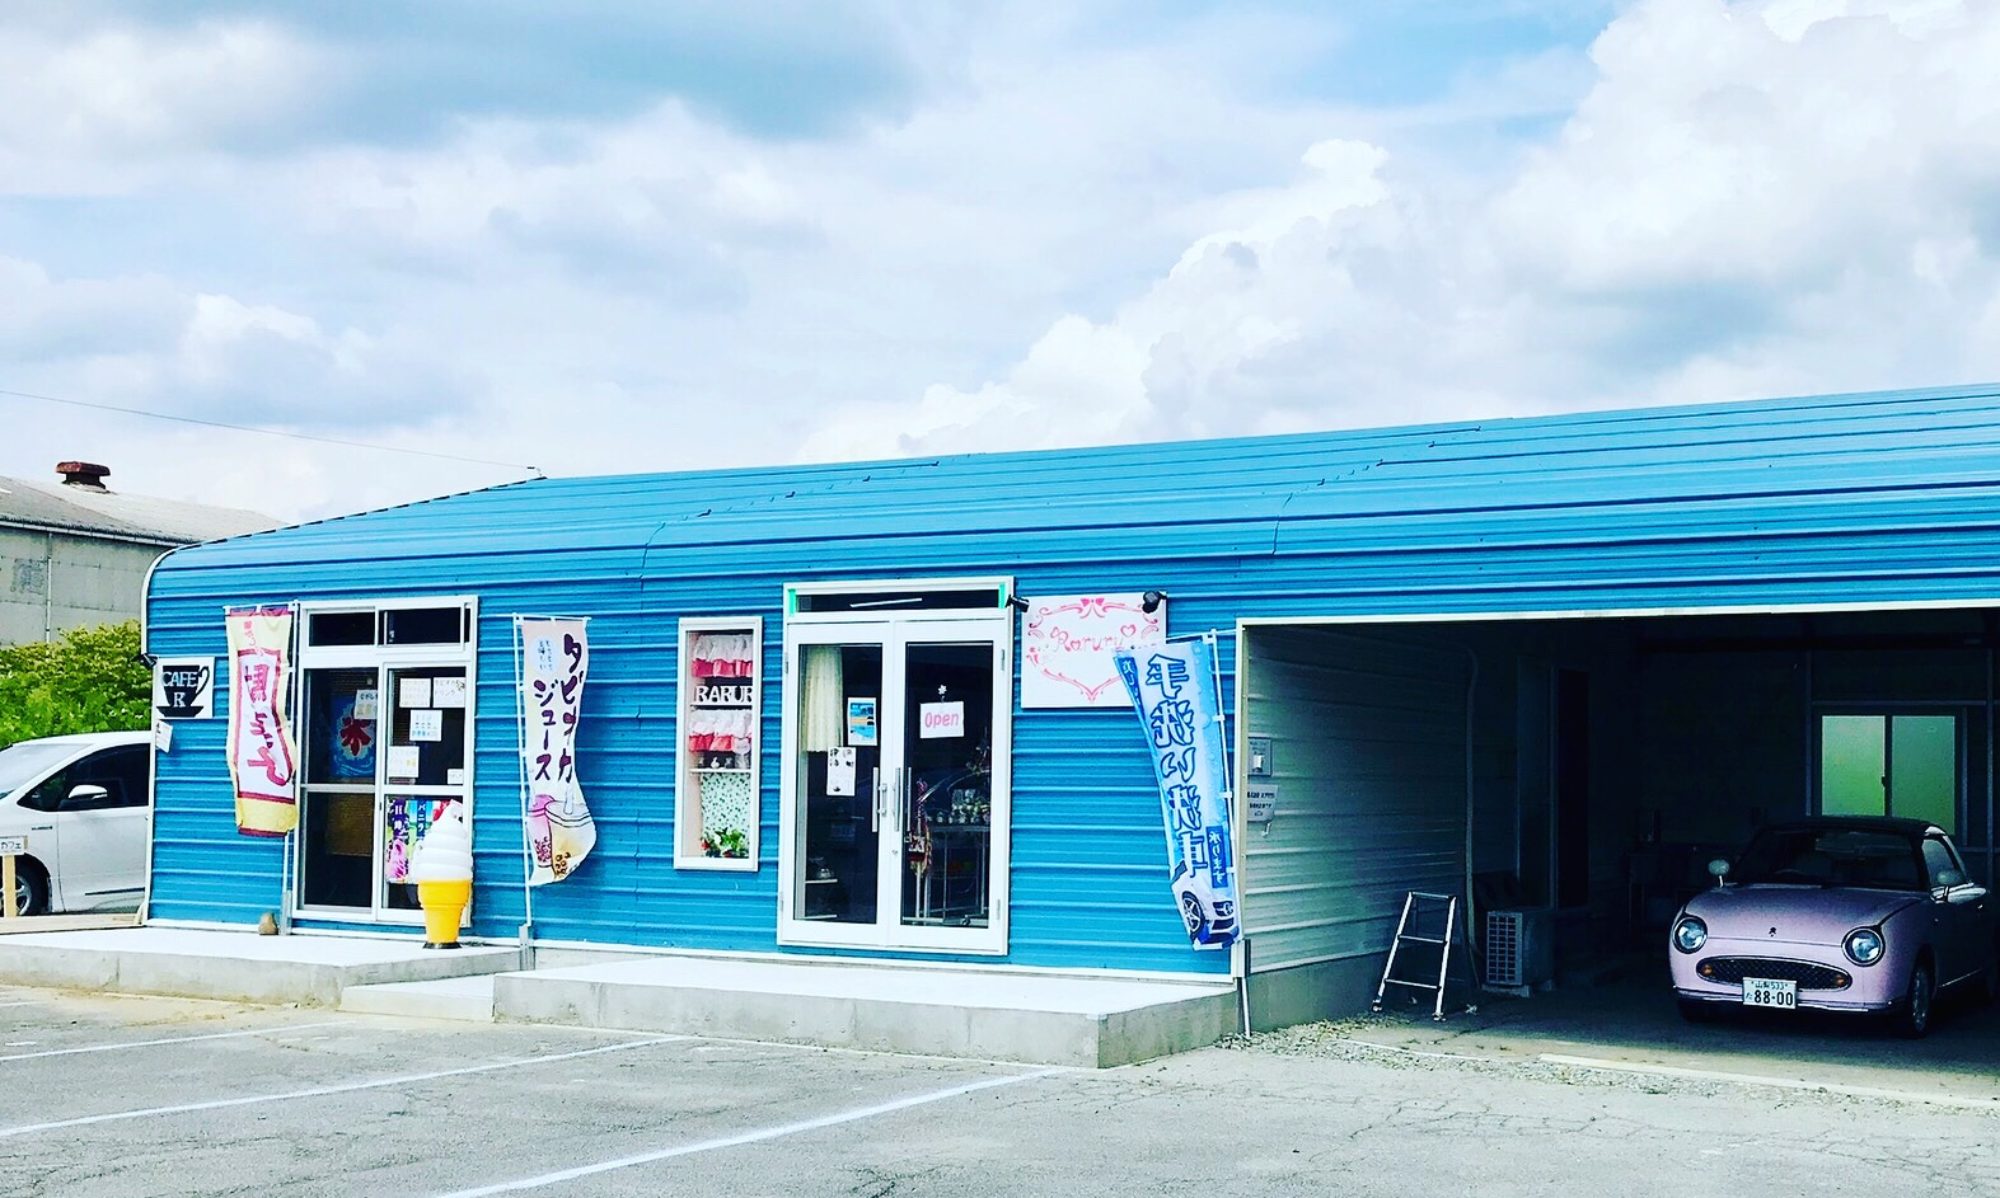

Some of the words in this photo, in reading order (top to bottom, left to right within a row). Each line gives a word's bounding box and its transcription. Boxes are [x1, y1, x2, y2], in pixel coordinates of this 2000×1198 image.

[162, 671, 198, 688] CAFE
[173, 692, 187, 708] R
[558, 633, 584, 783] タピオカ
[924, 712, 959, 729] Open
[533, 678, 559, 781] ジュース
